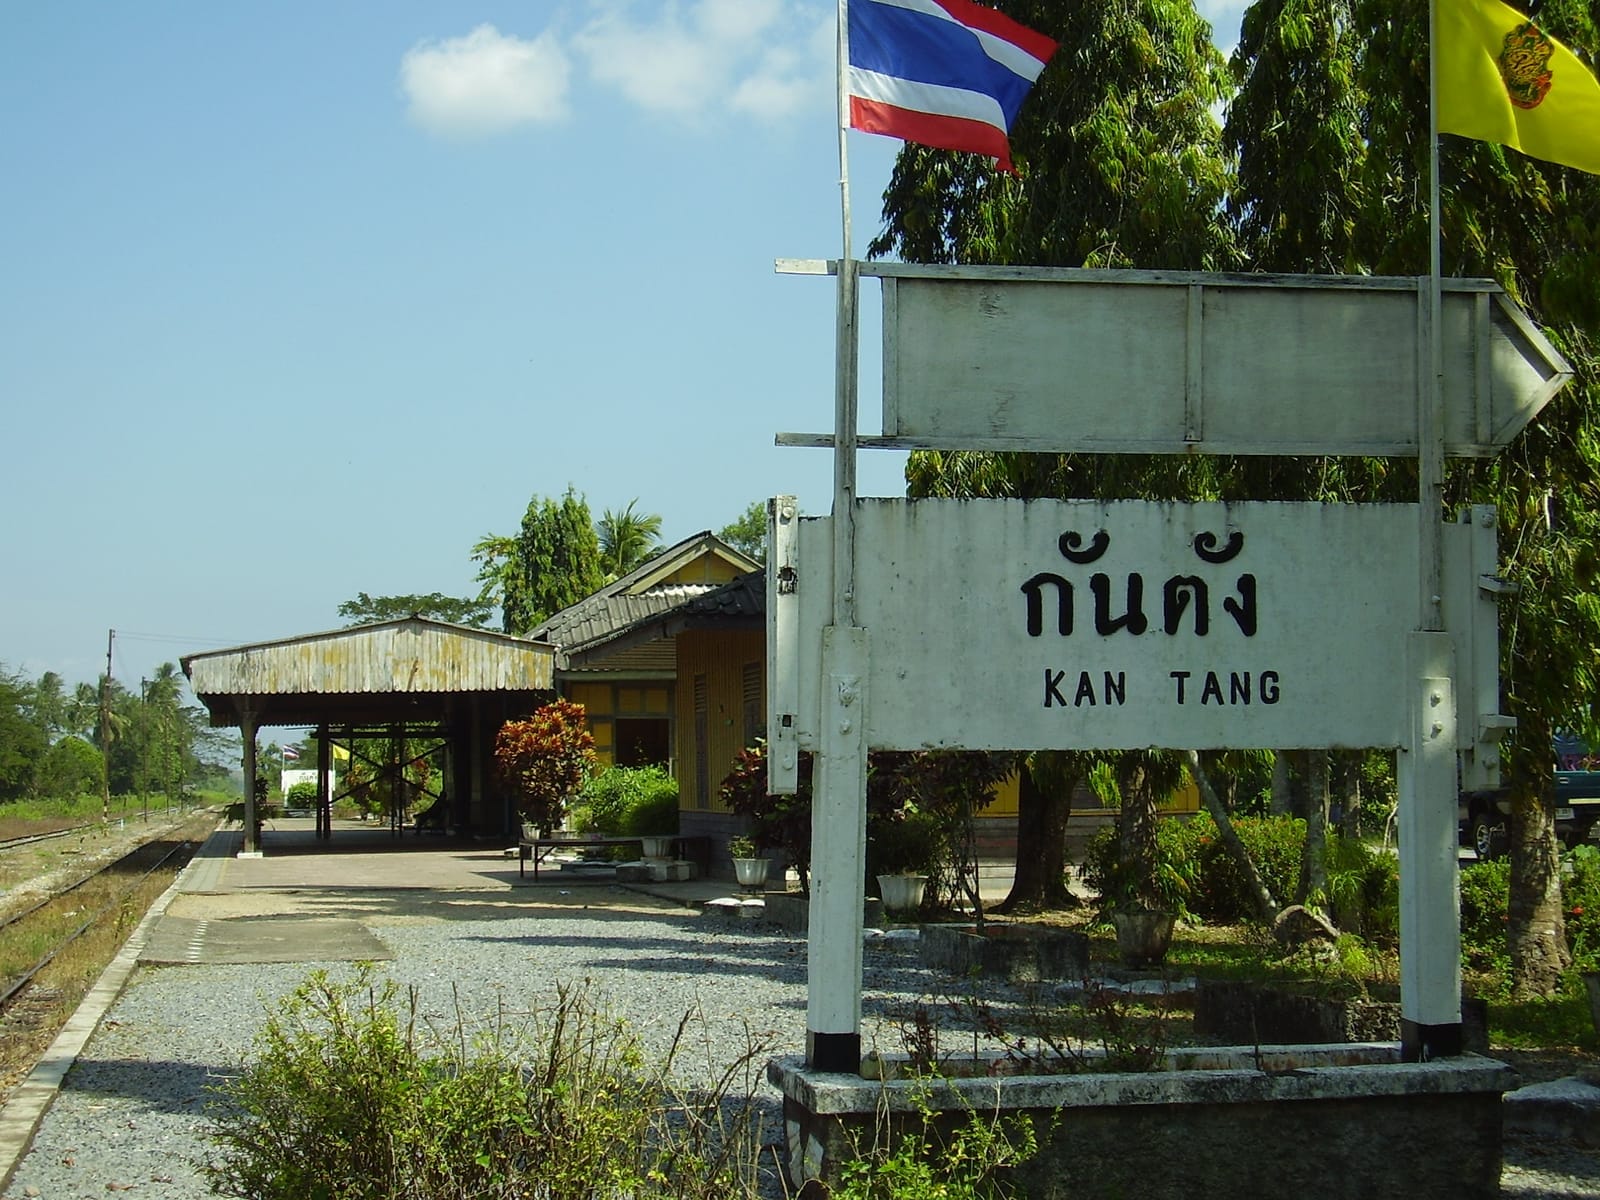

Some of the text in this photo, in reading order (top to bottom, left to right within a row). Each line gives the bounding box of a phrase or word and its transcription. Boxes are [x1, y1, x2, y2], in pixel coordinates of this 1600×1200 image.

[1020, 530, 1258, 638] กันตัง
[1044, 669, 1281, 708] KAN TANG
